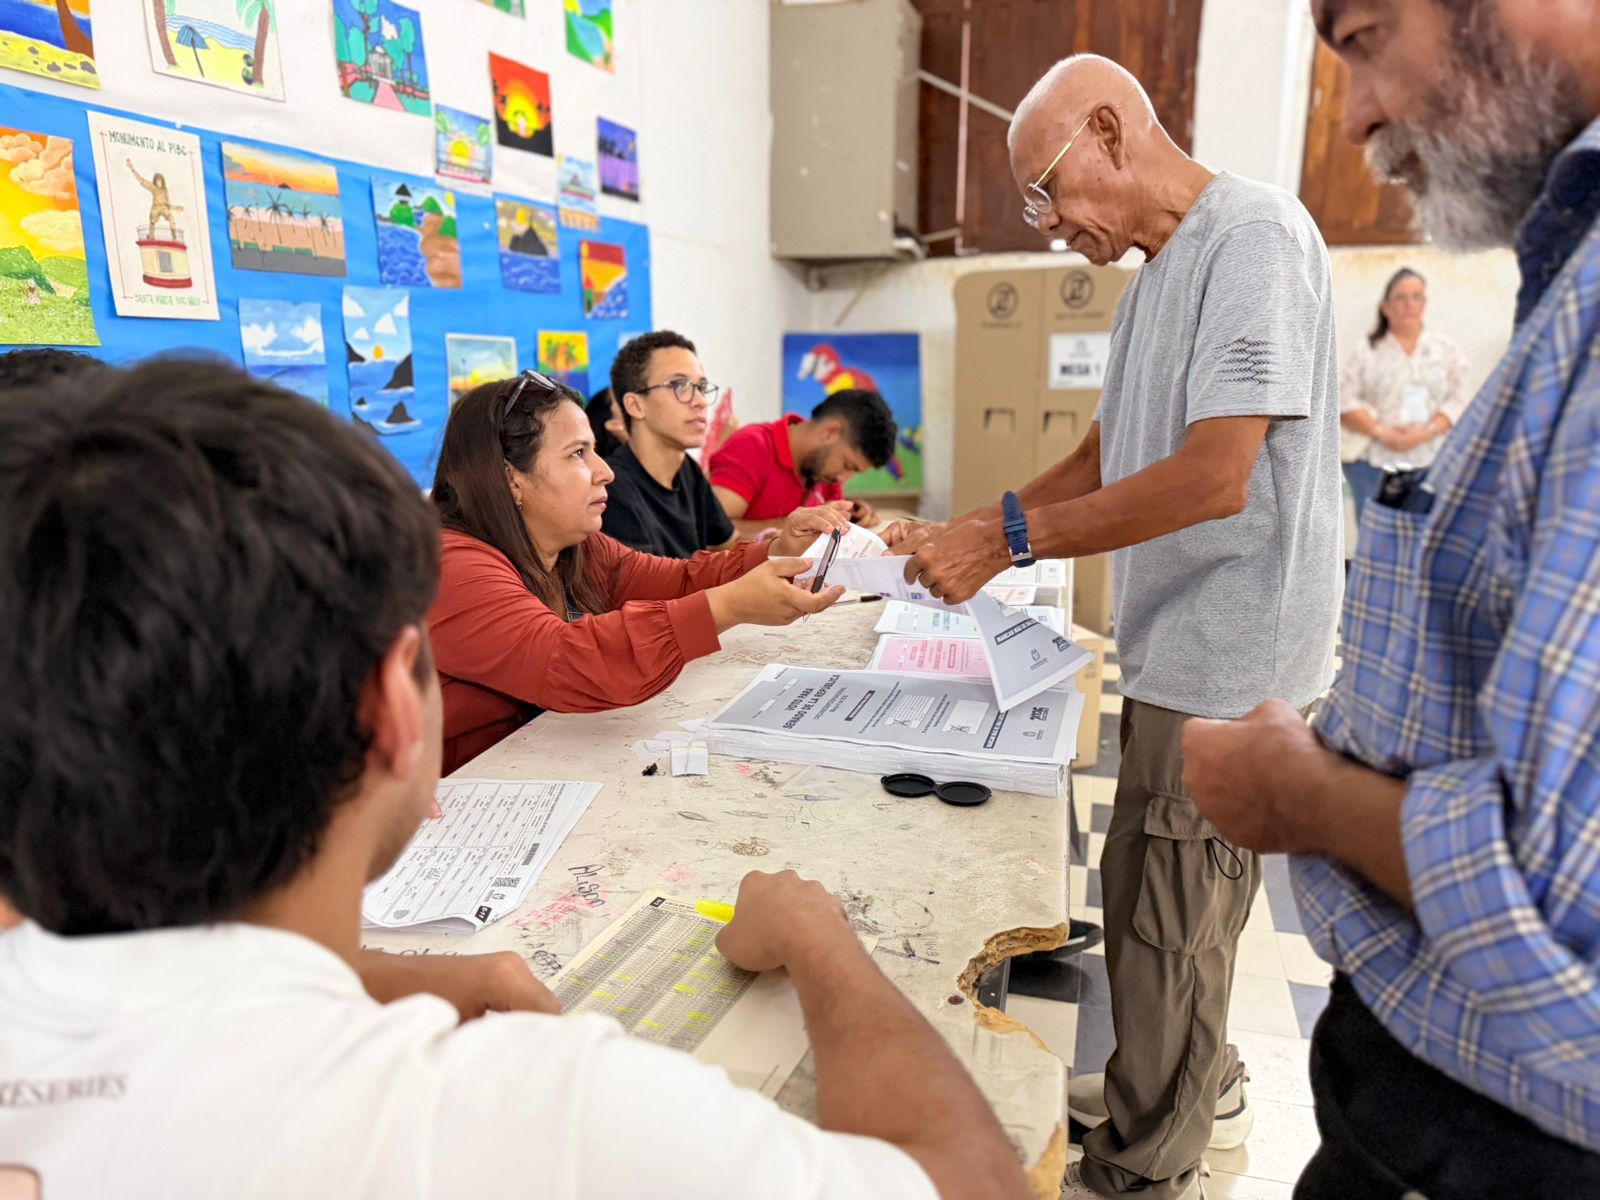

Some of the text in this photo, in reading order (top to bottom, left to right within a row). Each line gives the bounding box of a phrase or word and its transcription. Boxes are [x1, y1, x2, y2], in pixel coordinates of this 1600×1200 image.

[157, 140, 167, 153] AL
[784, 697, 802, 711] VOTO
[799, 687, 815, 699] PARA
[782, 710, 807, 729] SENADO
[802, 702, 814, 712] DE
[808, 696, 819, 705] LA
